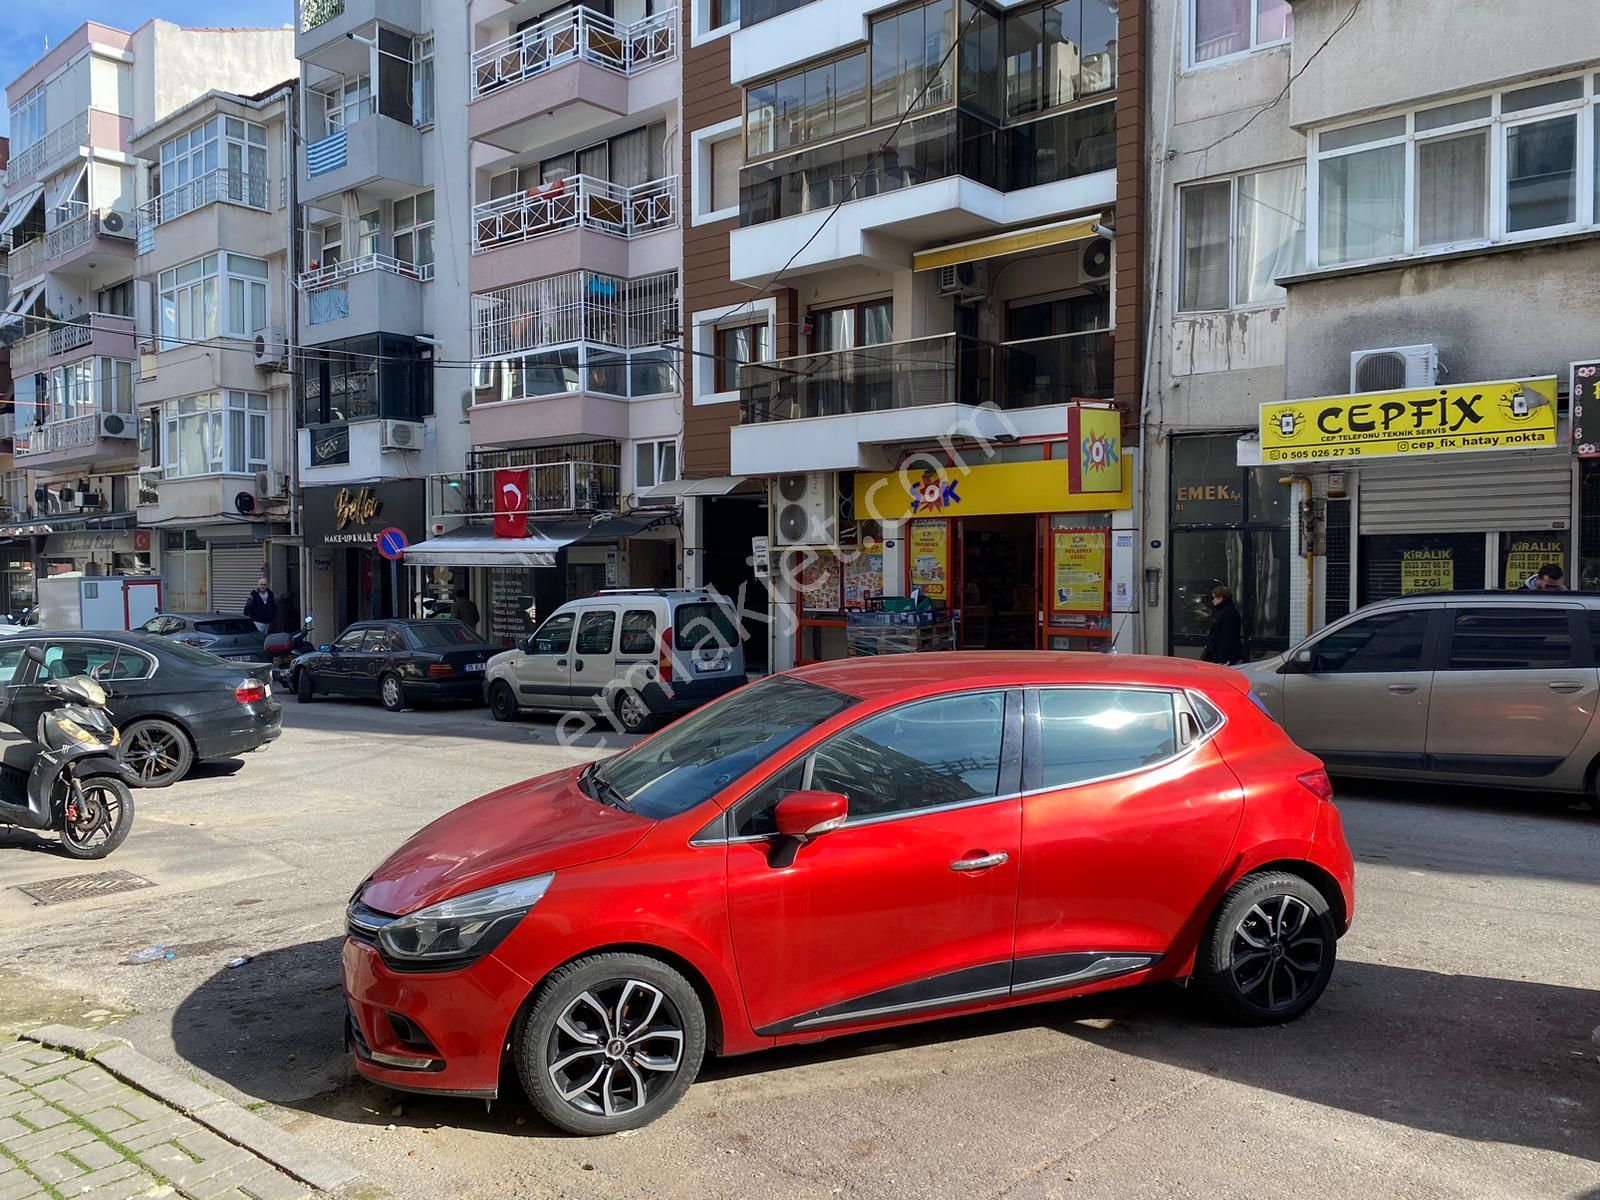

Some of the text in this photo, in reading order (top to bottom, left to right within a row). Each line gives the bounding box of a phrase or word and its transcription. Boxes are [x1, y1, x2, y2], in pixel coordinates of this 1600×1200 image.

[1338, 432, 1380, 441] TELEFONU
[1383, 428, 1413, 437] TEKNİK
[1416, 427, 1446, 435] SERVİS
[1082, 437, 1119, 475] ŞOK
[1290, 451, 1309, 459] 505
[1311, 450, 1330, 458] 026
[910, 479, 961, 513] ŞOK
[1176, 484, 1229, 500] EMEK
[1403, 550, 1450, 559] KİRALIK
